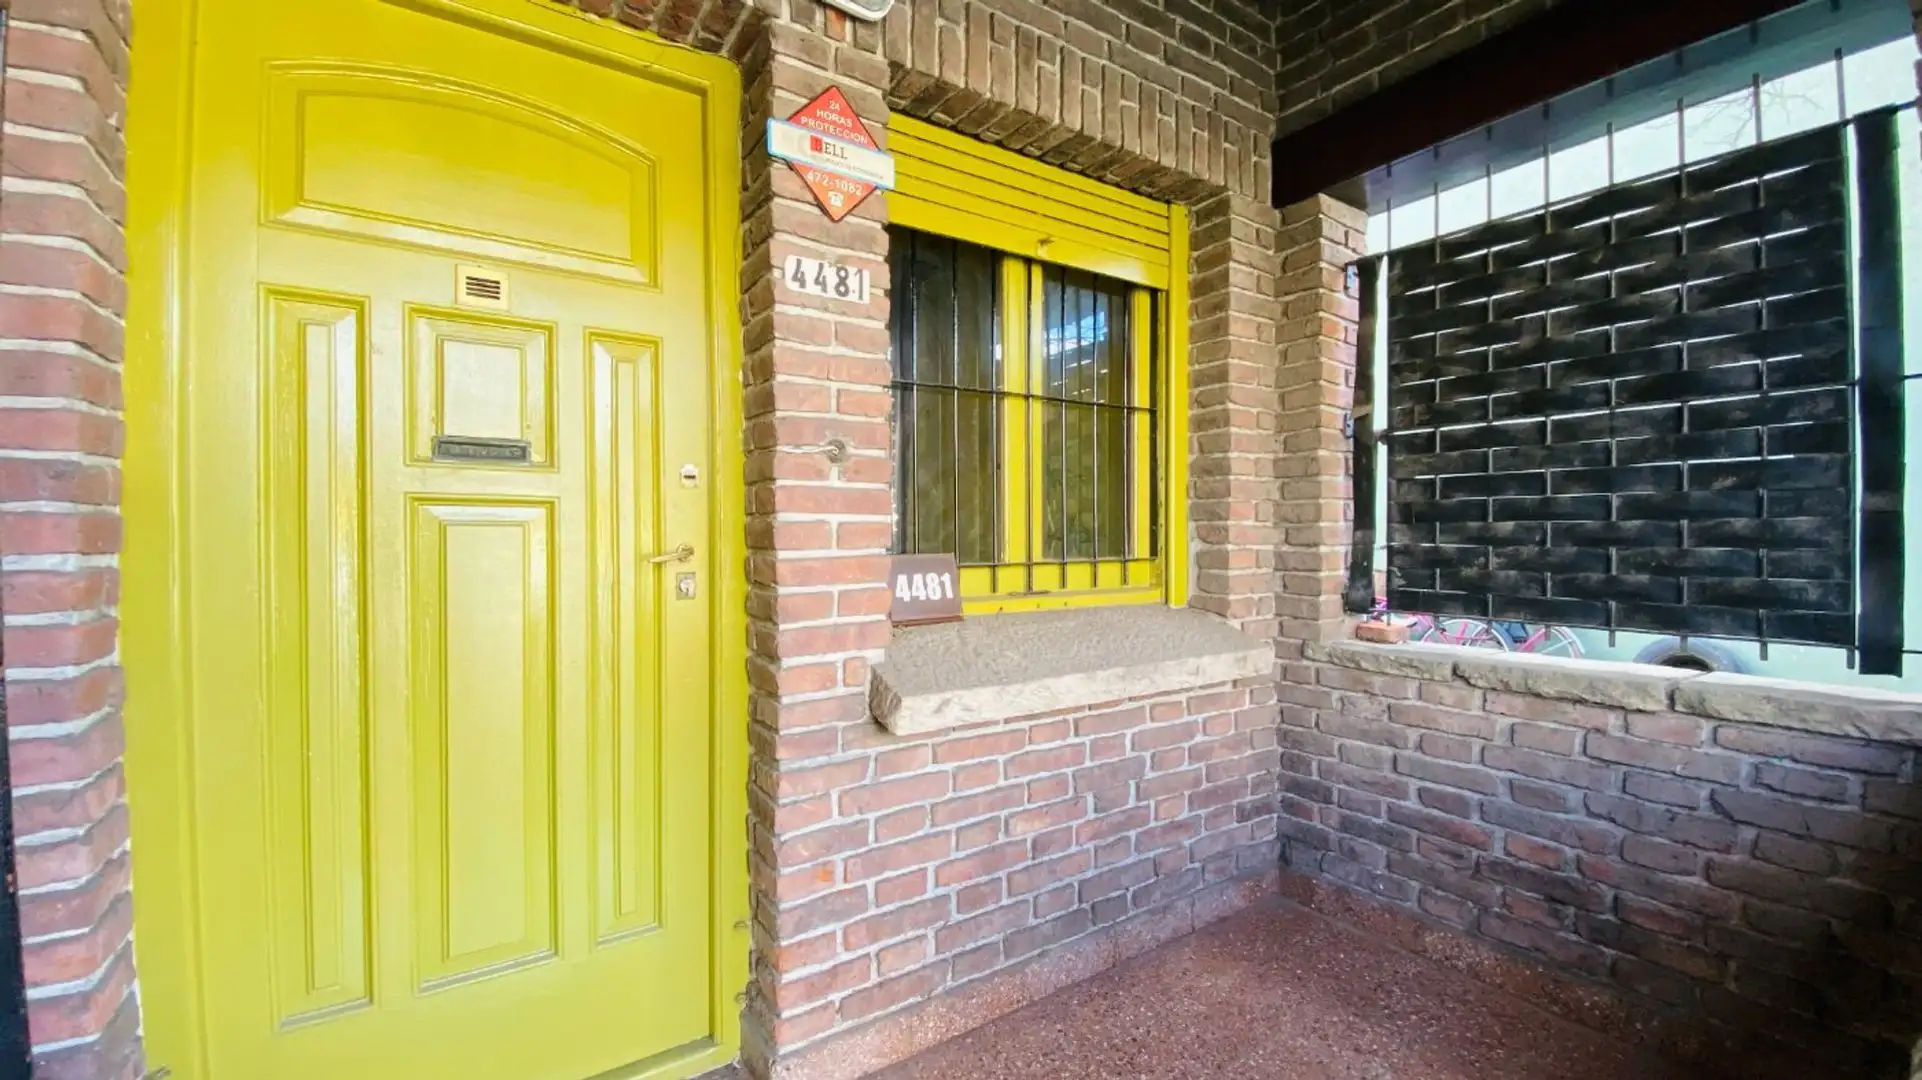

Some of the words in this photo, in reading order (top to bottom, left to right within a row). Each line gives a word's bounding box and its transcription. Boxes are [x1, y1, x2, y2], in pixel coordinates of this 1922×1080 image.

[816, 109, 853, 128] HORAS
[829, 100, 840, 110] 24
[800, 116, 868, 144] PROTECCION
[791, 258, 864, 301] 4481
[895, 572, 954, 602] 4481
